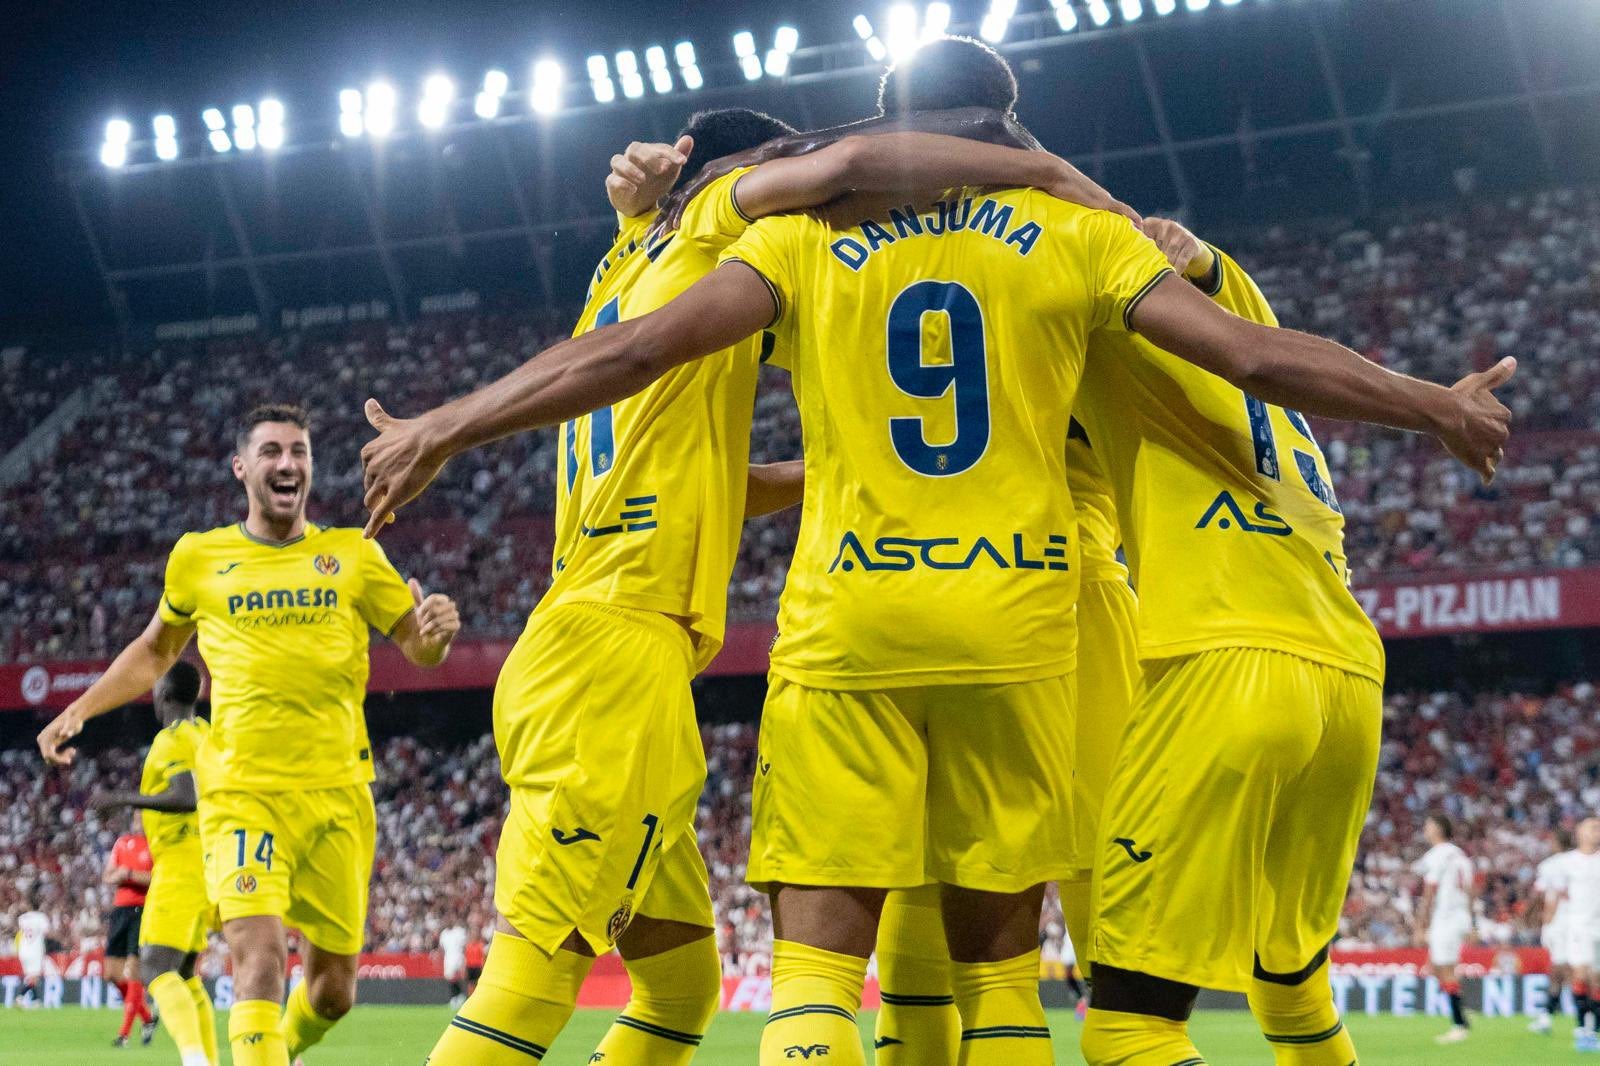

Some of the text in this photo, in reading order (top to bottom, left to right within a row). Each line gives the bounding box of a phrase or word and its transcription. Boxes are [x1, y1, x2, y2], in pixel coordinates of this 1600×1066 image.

[829, 197, 1044, 272] DANJUMA
[886, 279, 992, 478] 9
[827, 531, 1069, 574] ASCALE
[228, 588, 338, 615] PAMESA
[234, 829, 274, 872] 14
